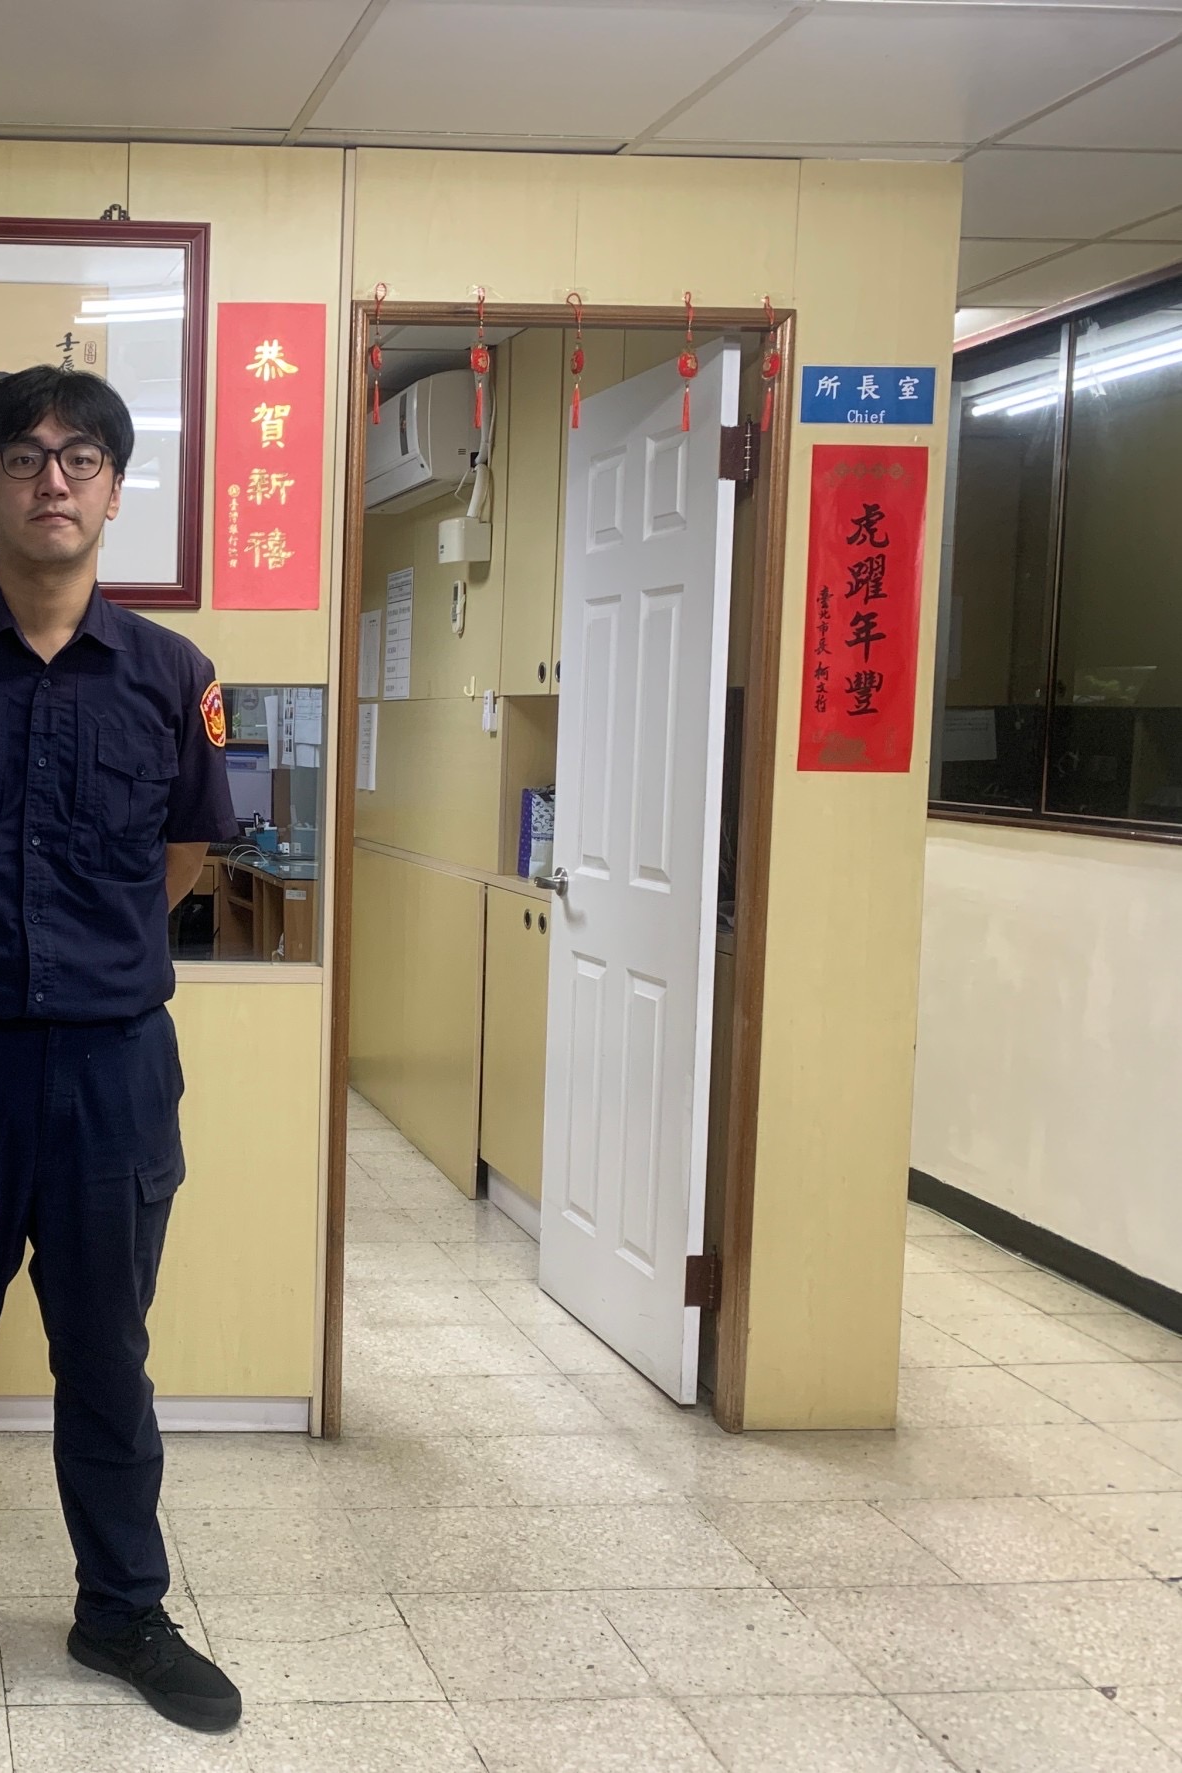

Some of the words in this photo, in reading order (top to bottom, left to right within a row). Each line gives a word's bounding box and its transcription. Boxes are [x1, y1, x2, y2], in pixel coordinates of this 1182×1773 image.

[815, 374, 920, 400] 所長室
[847, 409, 886, 424] Chief
[245, 339, 299, 570] 恭賀新禧
[814, 585, 834, 655] 臺北市長
[844, 503, 890, 716] 虎躍年豐
